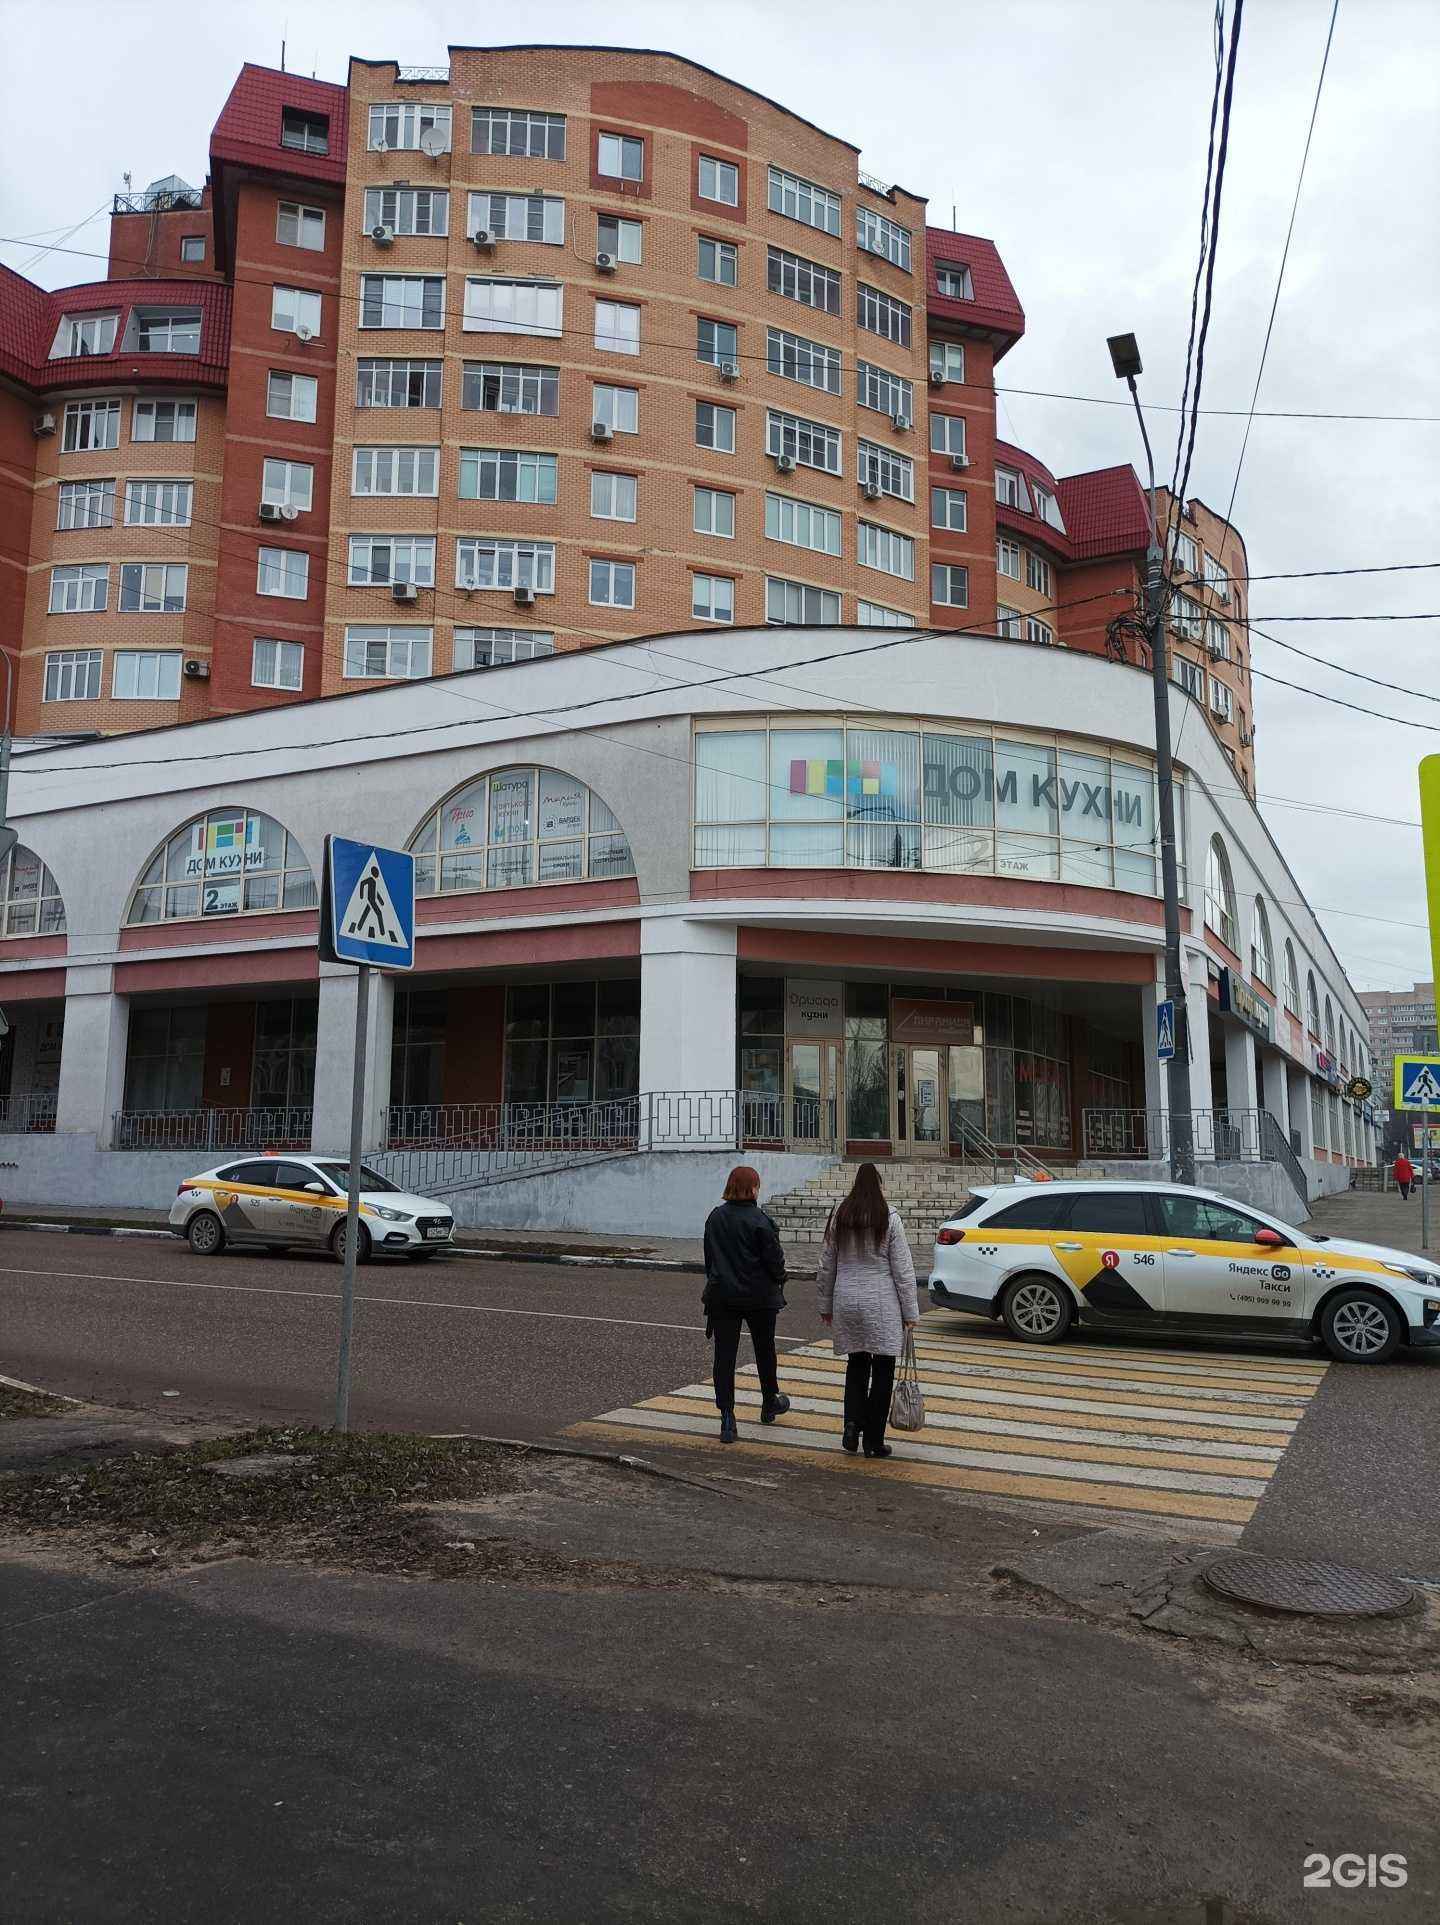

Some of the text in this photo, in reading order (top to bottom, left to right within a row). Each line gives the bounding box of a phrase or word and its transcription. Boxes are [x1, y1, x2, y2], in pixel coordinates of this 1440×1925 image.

[923, 763, 1142, 827] ДОМ КУХНИ
[186, 851, 263, 875] ДОМ КУХНИ
[205, 889, 219, 911] 2
[801, 1011, 829, 1021] кухни
[1133, 1253, 1155, 1266] 546
[1228, 1262, 1290, 1280] Яндекс Go
[1259, 1279, 1291, 1293] Такси
